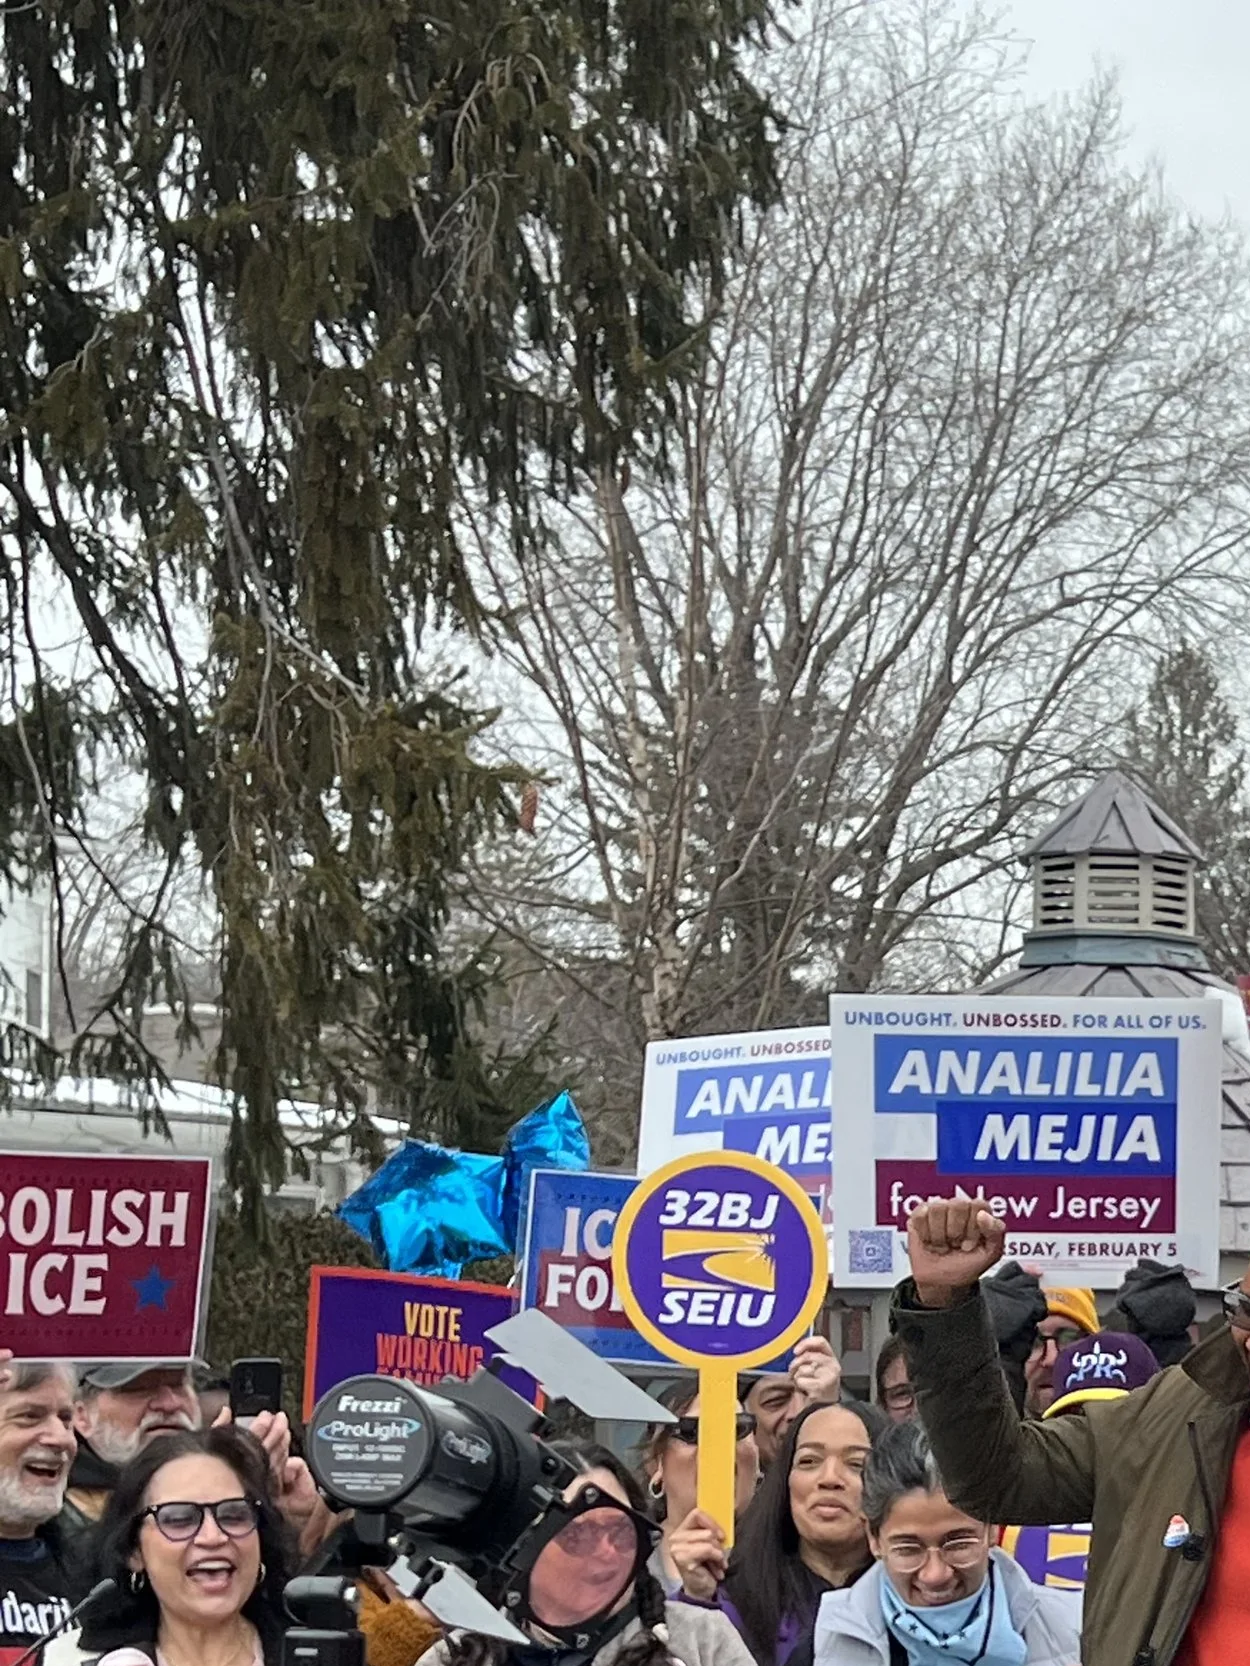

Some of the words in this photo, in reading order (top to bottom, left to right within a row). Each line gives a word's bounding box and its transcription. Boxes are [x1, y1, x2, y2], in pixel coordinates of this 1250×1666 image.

[845, 1011, 957, 1028] UNBOUGHT.
[963, 1012, 1068, 1029] UNBOSSED.
[1072, 1014, 1108, 1029] FOR
[1113, 1015, 1144, 1029] ALL
[1149, 1015, 1174, 1030] OF
[1178, 1015, 1207, 1030] US.
[888, 1049, 1165, 1097] ANALILIA
[974, 1113, 1161, 1163] MEJIA
[0, 1186, 191, 1247] OLISH
[659, 1189, 780, 1229] 32BJ
[1049, 1186, 1161, 1228] Jersey
[561, 1207, 618, 1260] IC
[1003, 1241, 1060, 1259] SDAY,
[1068, 1242, 1161, 1257] FEBRUARY
[1168, 1242, 1178, 1257] 5
[4, 1252, 109, 1316] ICE
[404, 1301, 463, 1343] VOTE
[658, 1290, 776, 1327] SEIU
[338, 1395, 401, 1414] Frezzi
[331, 1420, 410, 1441] ProLight
